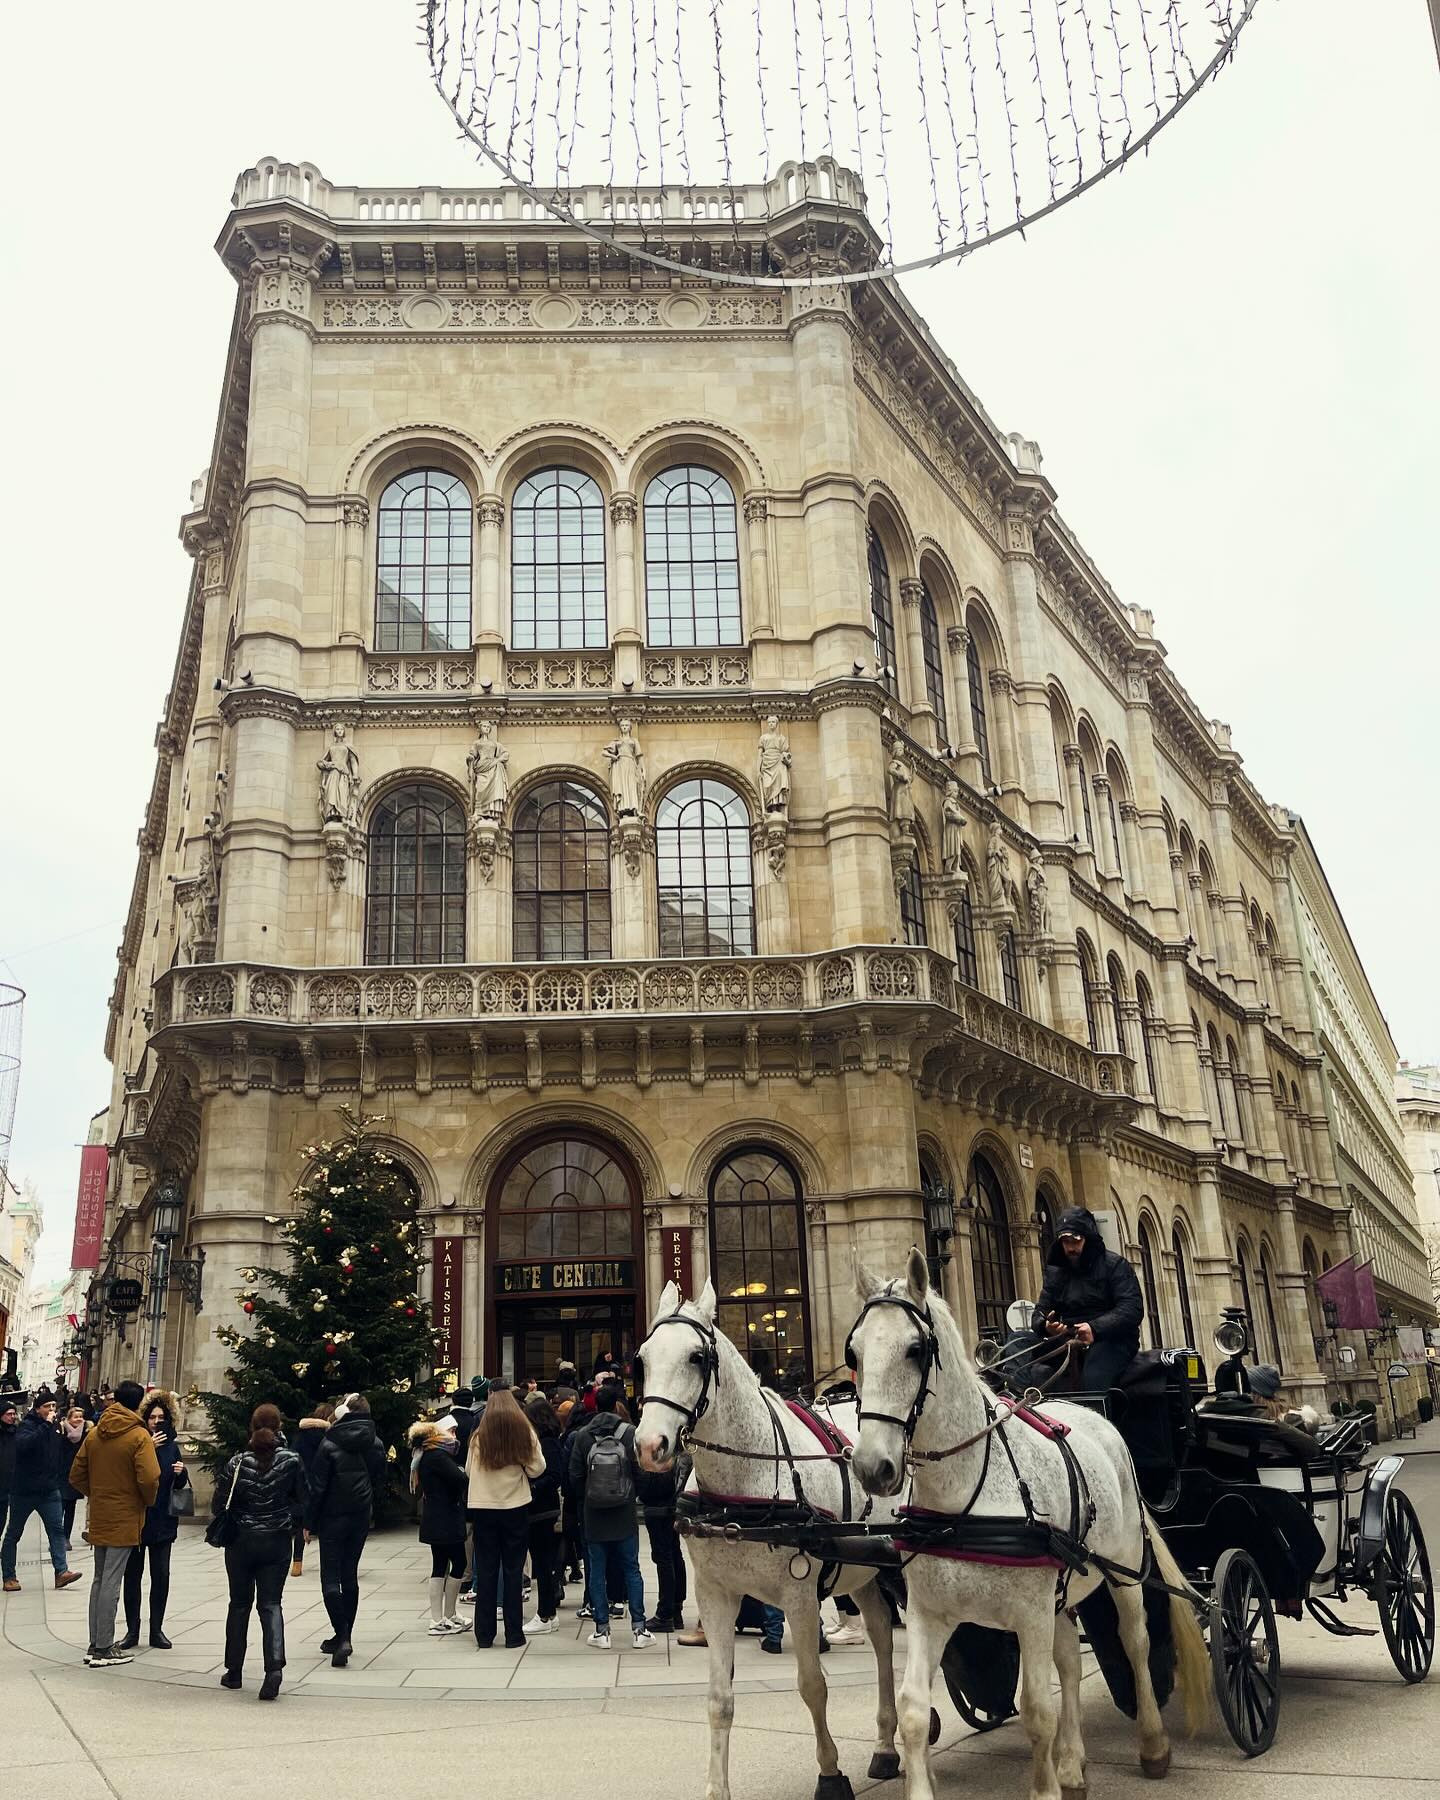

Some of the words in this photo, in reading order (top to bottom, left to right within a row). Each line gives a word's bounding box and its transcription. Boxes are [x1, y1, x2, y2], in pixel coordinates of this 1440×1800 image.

[80, 1168, 93, 1227] FERSTEL
[90, 1169, 102, 1227] PASSAGE
[553, 1263, 623, 1288] CENTRAL
